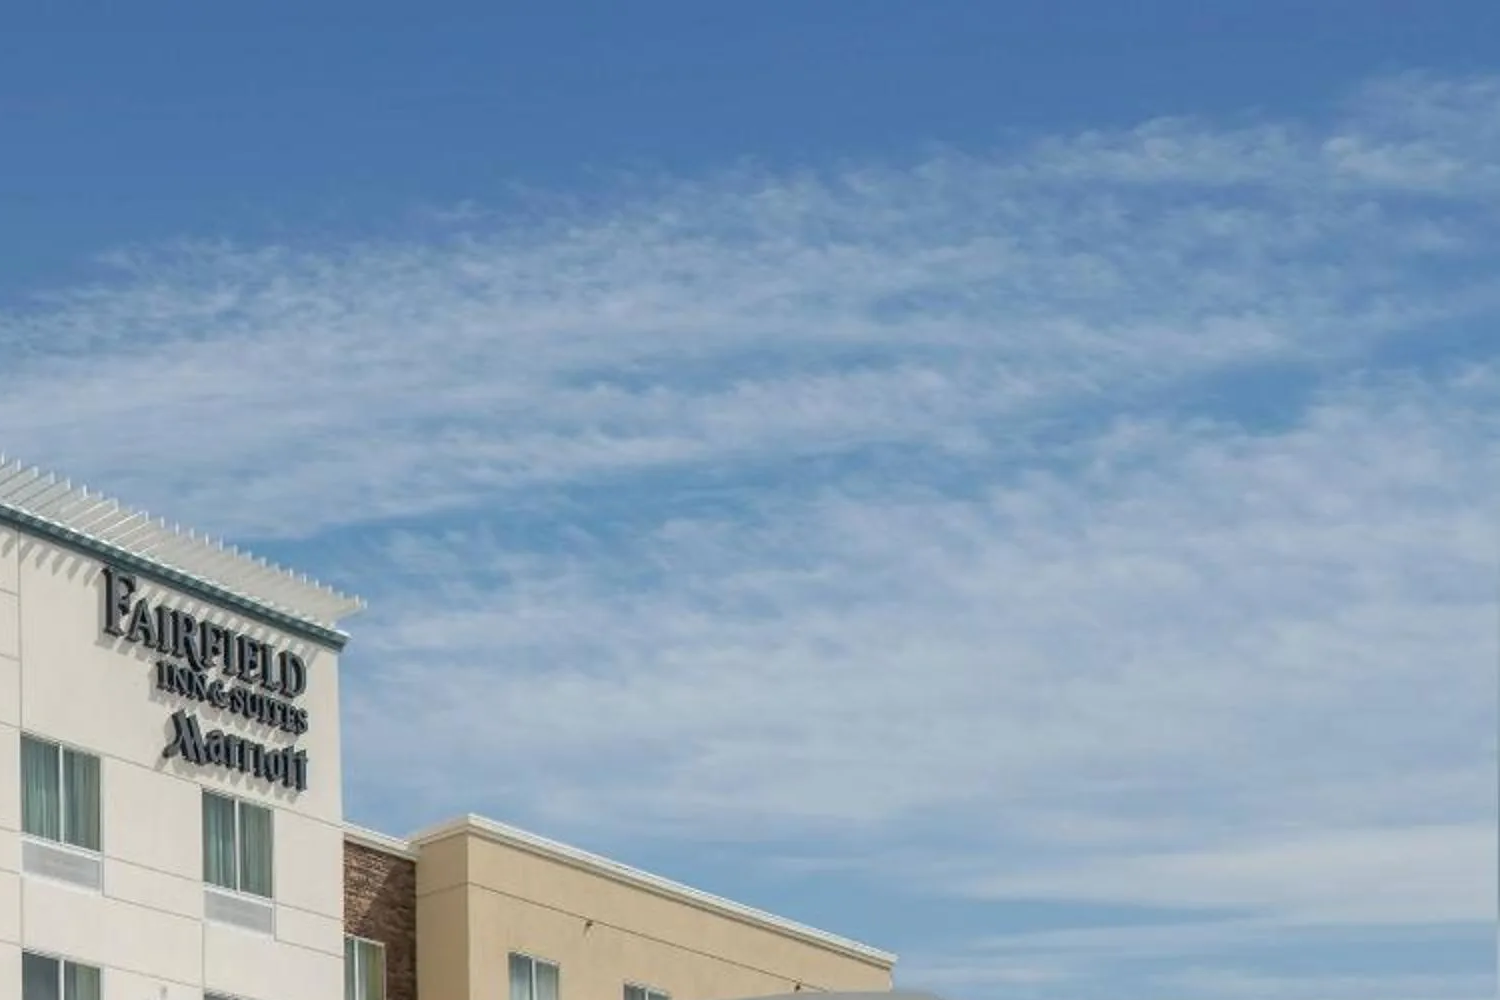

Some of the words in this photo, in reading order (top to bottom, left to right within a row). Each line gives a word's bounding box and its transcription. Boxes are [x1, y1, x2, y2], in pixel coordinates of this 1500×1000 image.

[102, 567, 307, 699] FAIRFIELD
[156, 662, 207, 702] INN
[206, 679, 229, 709] &
[229, 686, 308, 735] SUITES
[162, 709, 308, 791] Marriott
